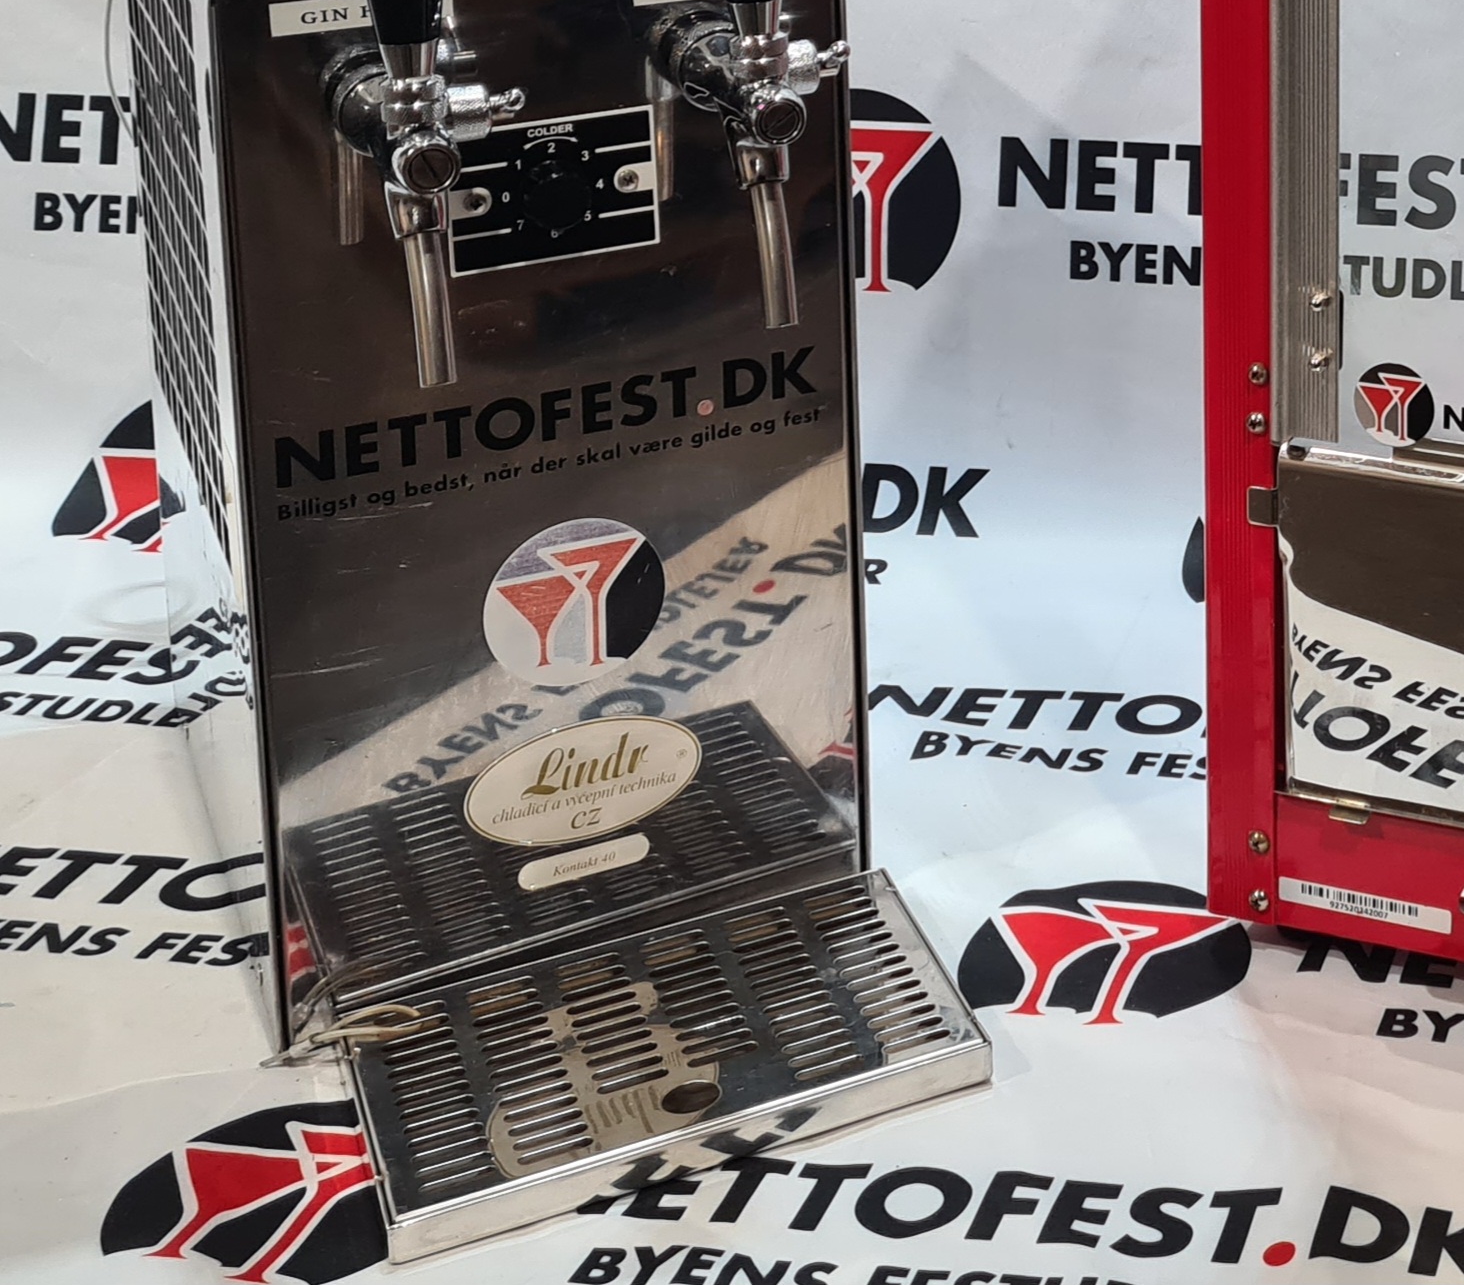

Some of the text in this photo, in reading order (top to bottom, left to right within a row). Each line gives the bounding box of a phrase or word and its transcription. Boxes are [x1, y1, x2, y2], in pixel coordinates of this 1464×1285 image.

[301, 7, 349, 25] GIN
[527, 123, 573, 138] COLDER
[547, 143, 556, 153] 2
[581, 151, 589, 161] 3
[515, 160, 522, 170] 1
[595, 178, 604, 189] 4
[584, 211, 592, 221] 5
[517, 220, 525, 230] 7
[275, 345, 818, 489] NETTOFEST.DK
[277, 405, 821, 522] Billigst og bedst, når der skal være gilde og fest
[910, 730, 1108, 772] BYENS
[520, 732, 649, 800] Lindr
[552, 800, 560, 812] a
[619, 771, 677, 795] technika
[552, 851, 616, 877] Kontakt 40
